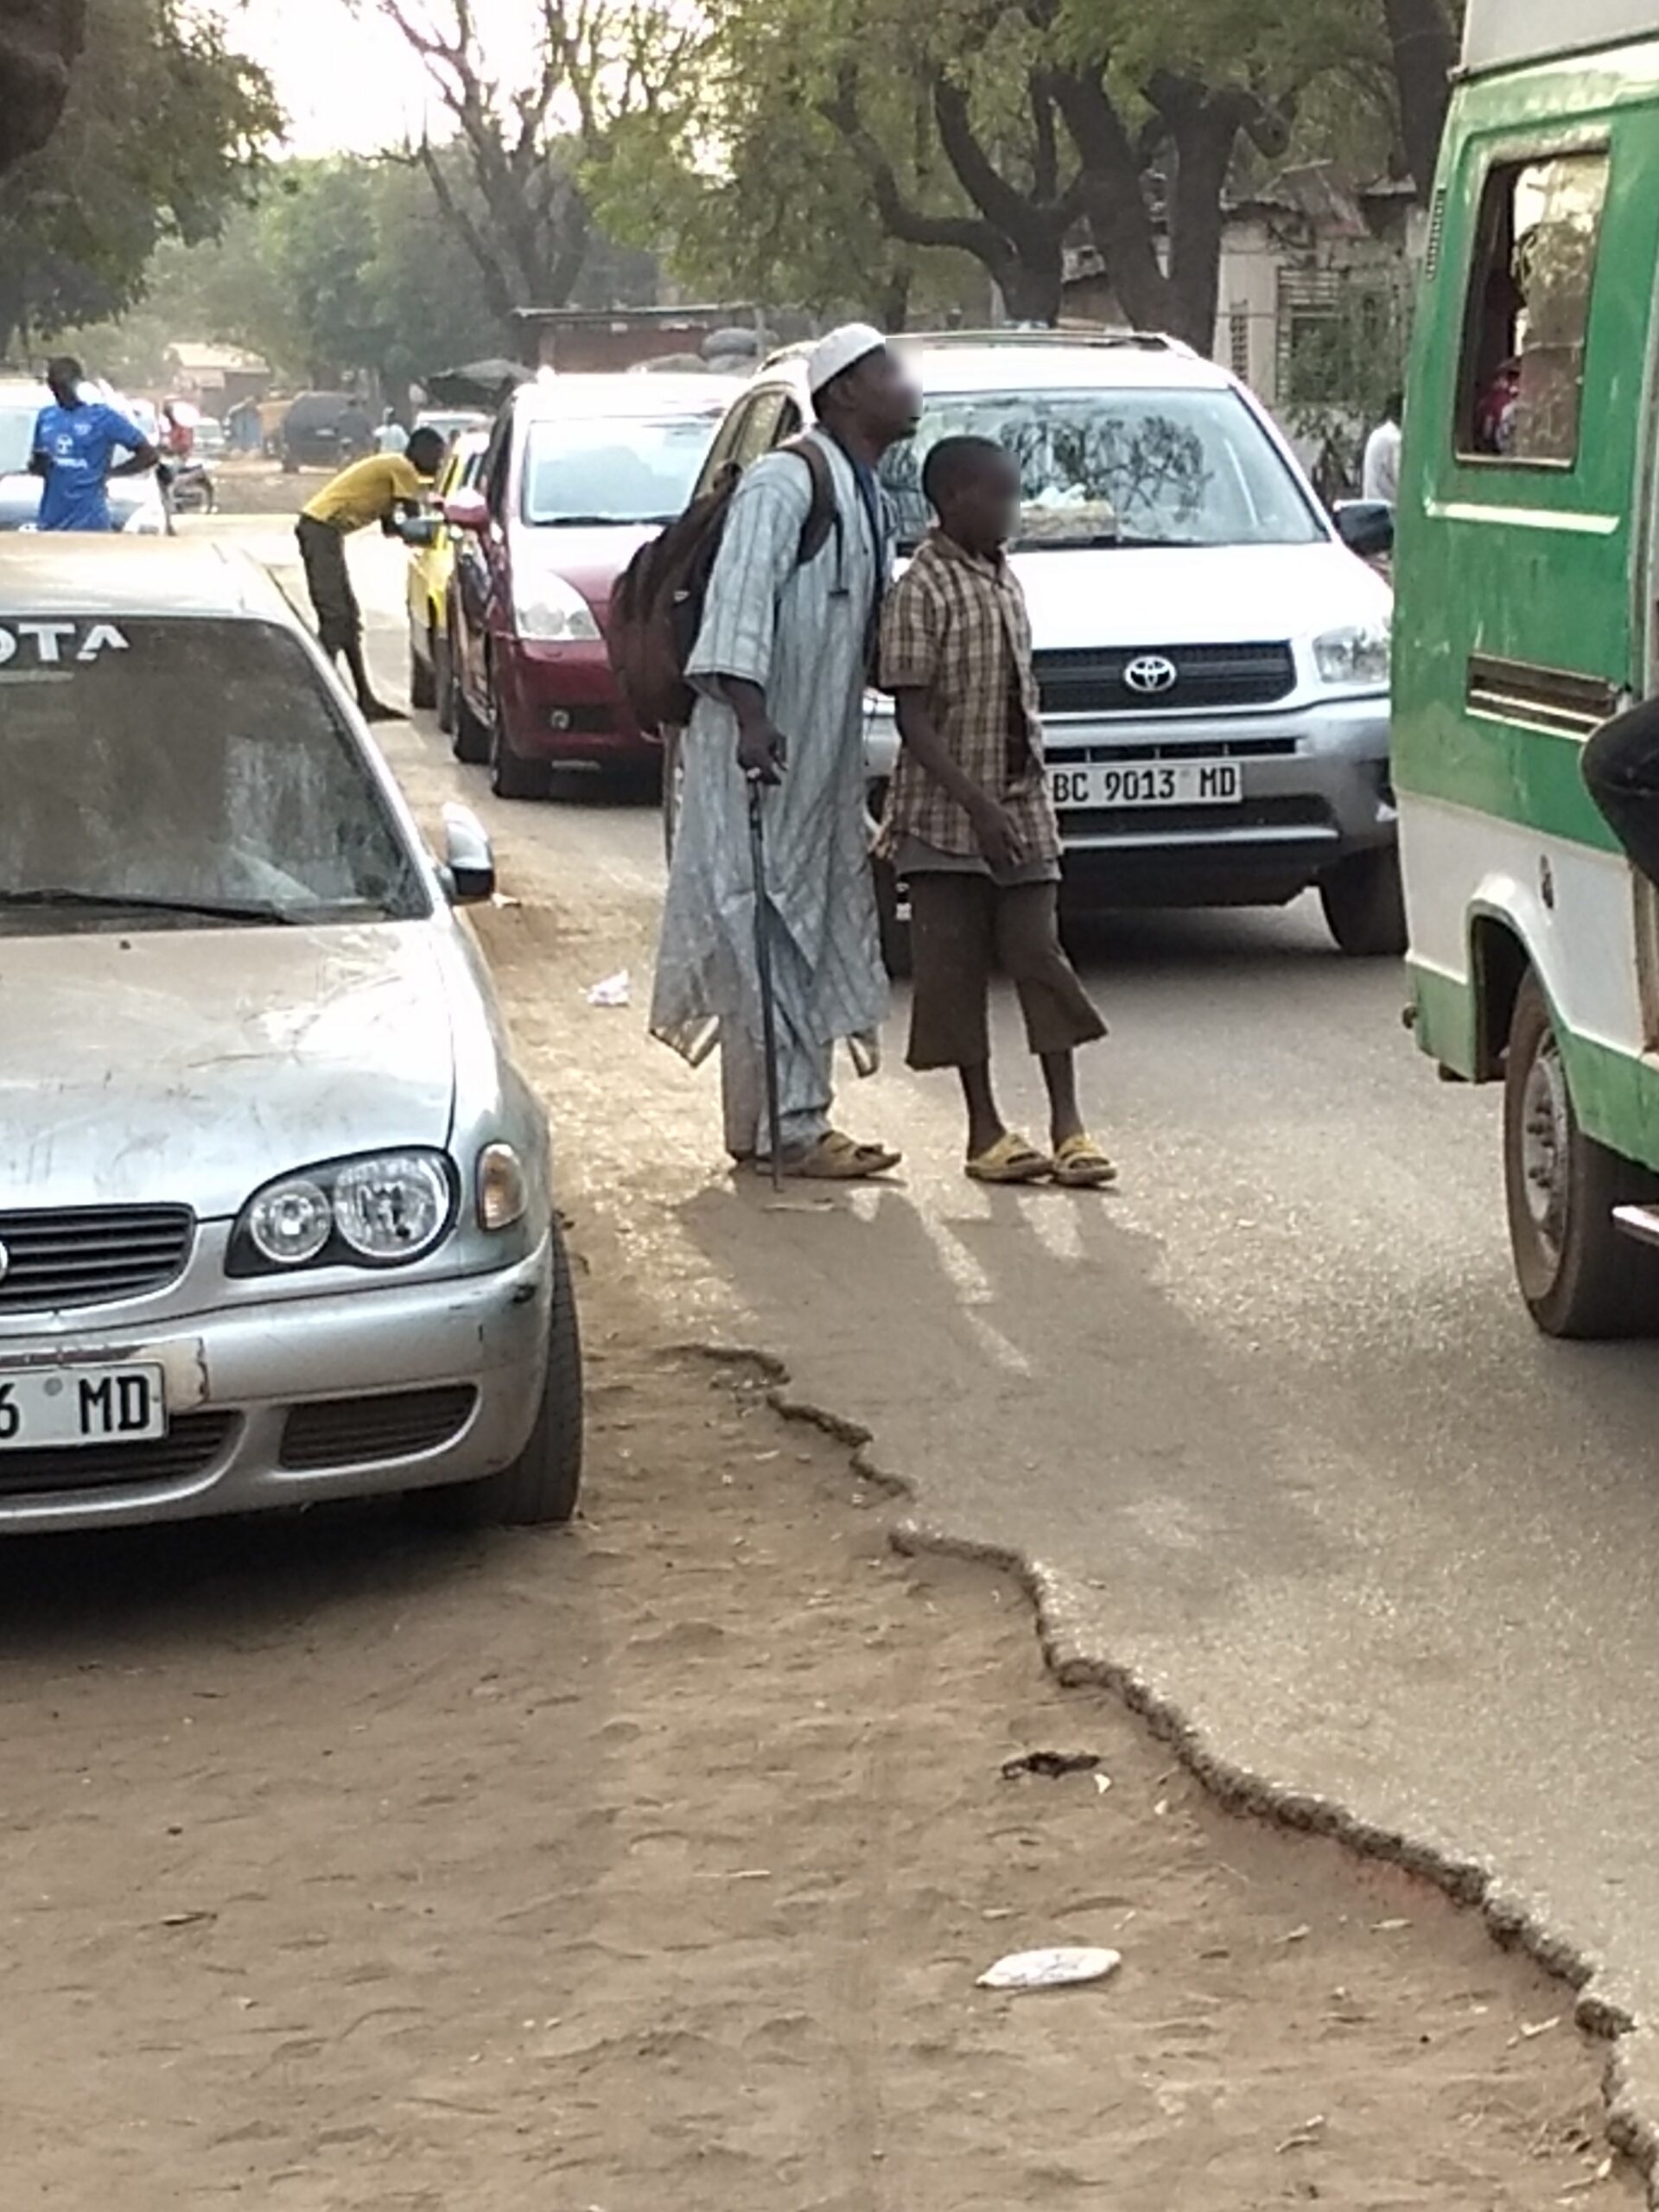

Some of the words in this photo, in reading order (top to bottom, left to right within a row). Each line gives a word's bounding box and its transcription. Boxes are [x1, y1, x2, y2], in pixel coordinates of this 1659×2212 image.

[1052, 772, 1089, 803] BC
[1104, 769, 1175, 801] 9013
[1199, 766, 1236, 797] MD
[79, 1375, 150, 1434] MD
